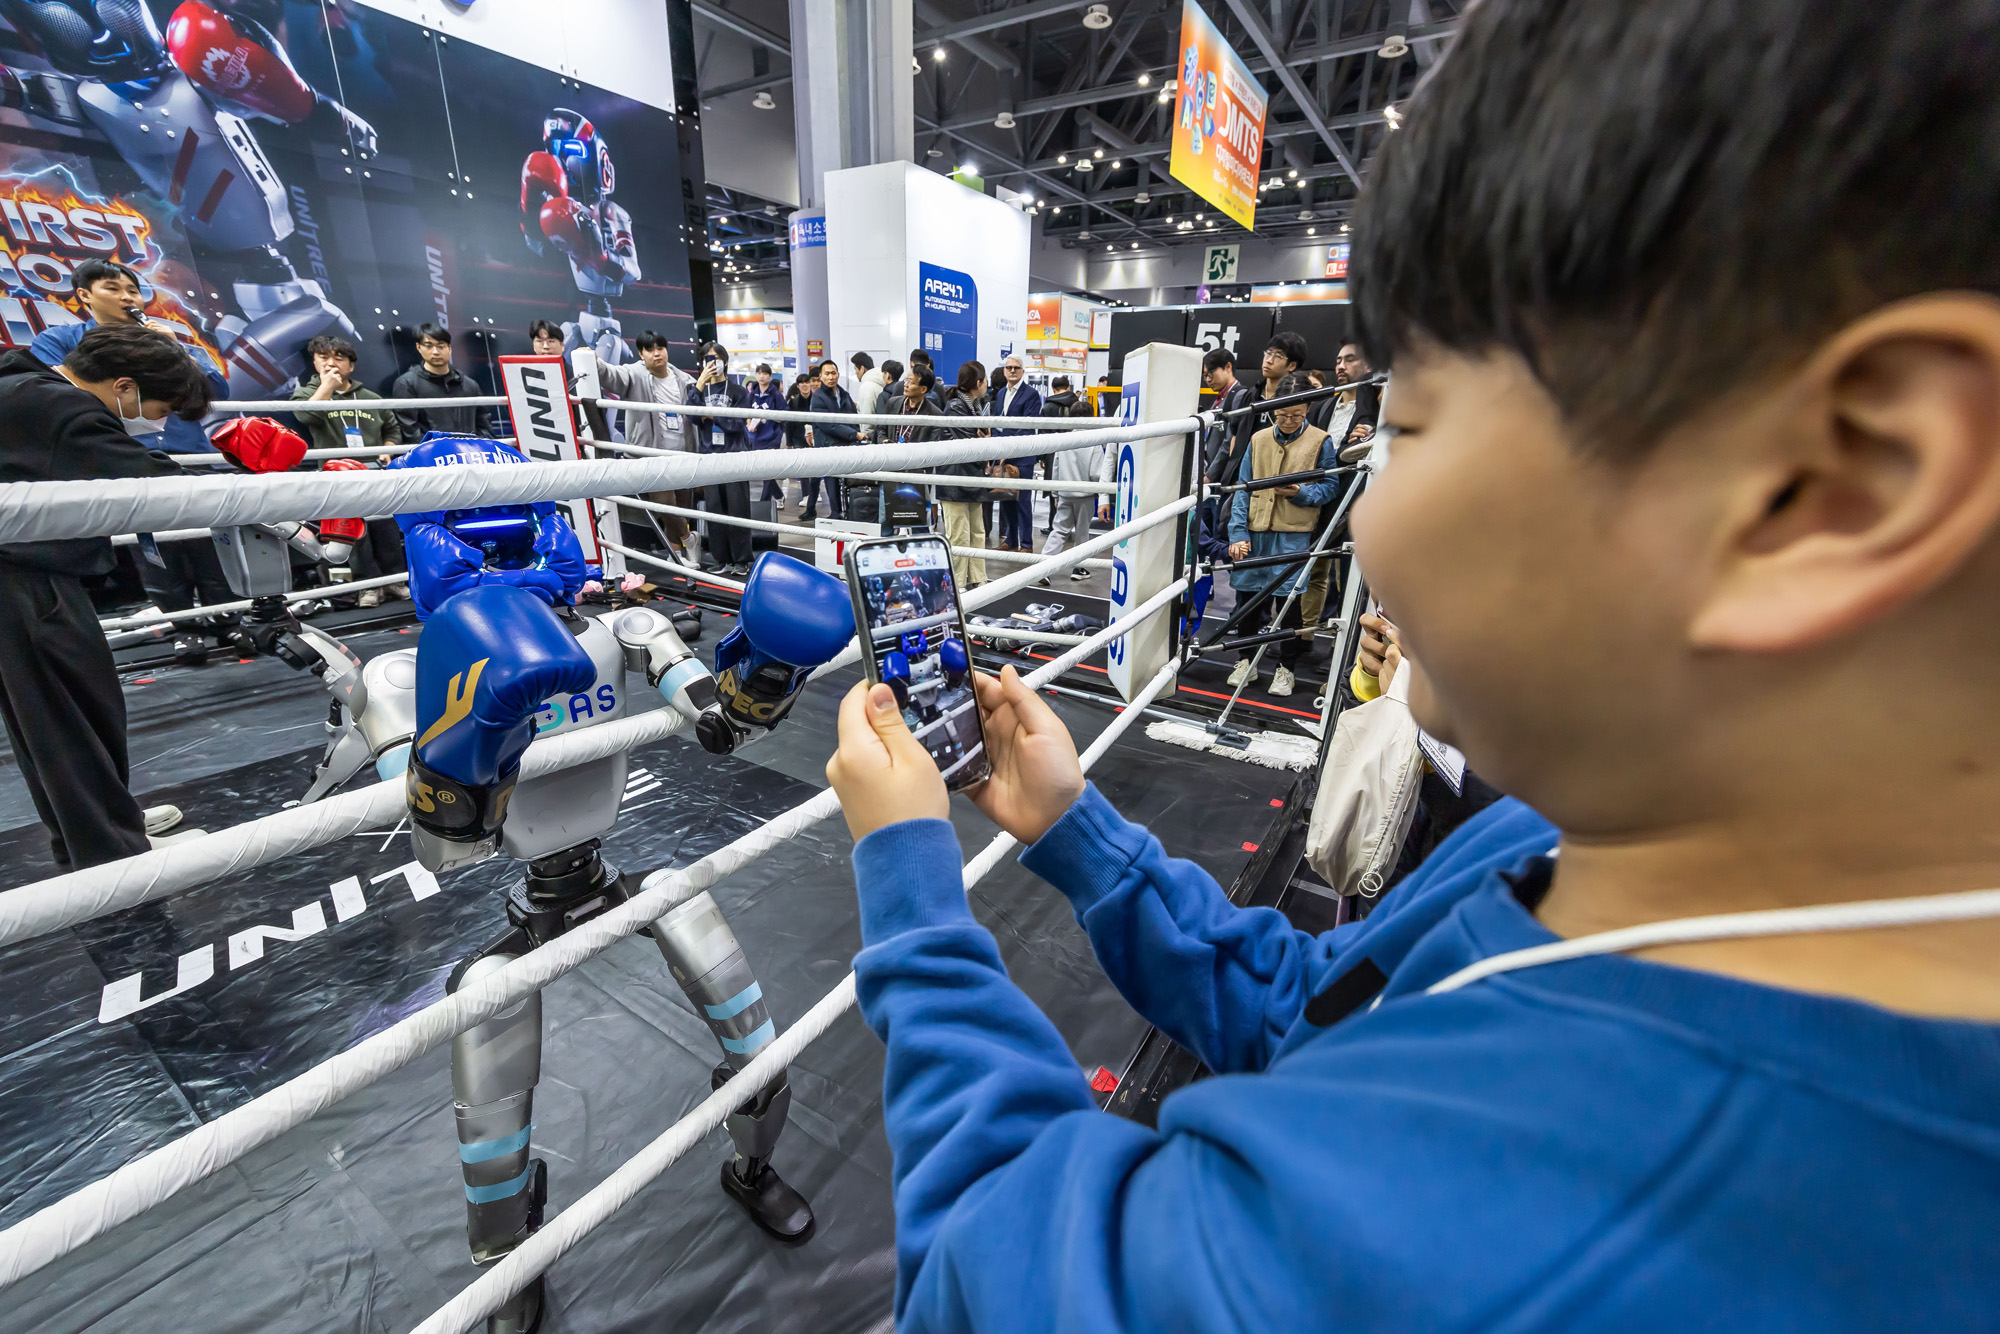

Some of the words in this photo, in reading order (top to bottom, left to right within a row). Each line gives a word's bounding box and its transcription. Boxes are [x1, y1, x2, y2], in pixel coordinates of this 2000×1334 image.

[1218, 91, 1259, 165] DMTS
[0, 197, 146, 254] IRST
[290, 184, 332, 293] UNITREE
[425, 245, 450, 330] UNITR
[1195, 323, 1240, 361] 5t
[328, 411, 339, 419] no
